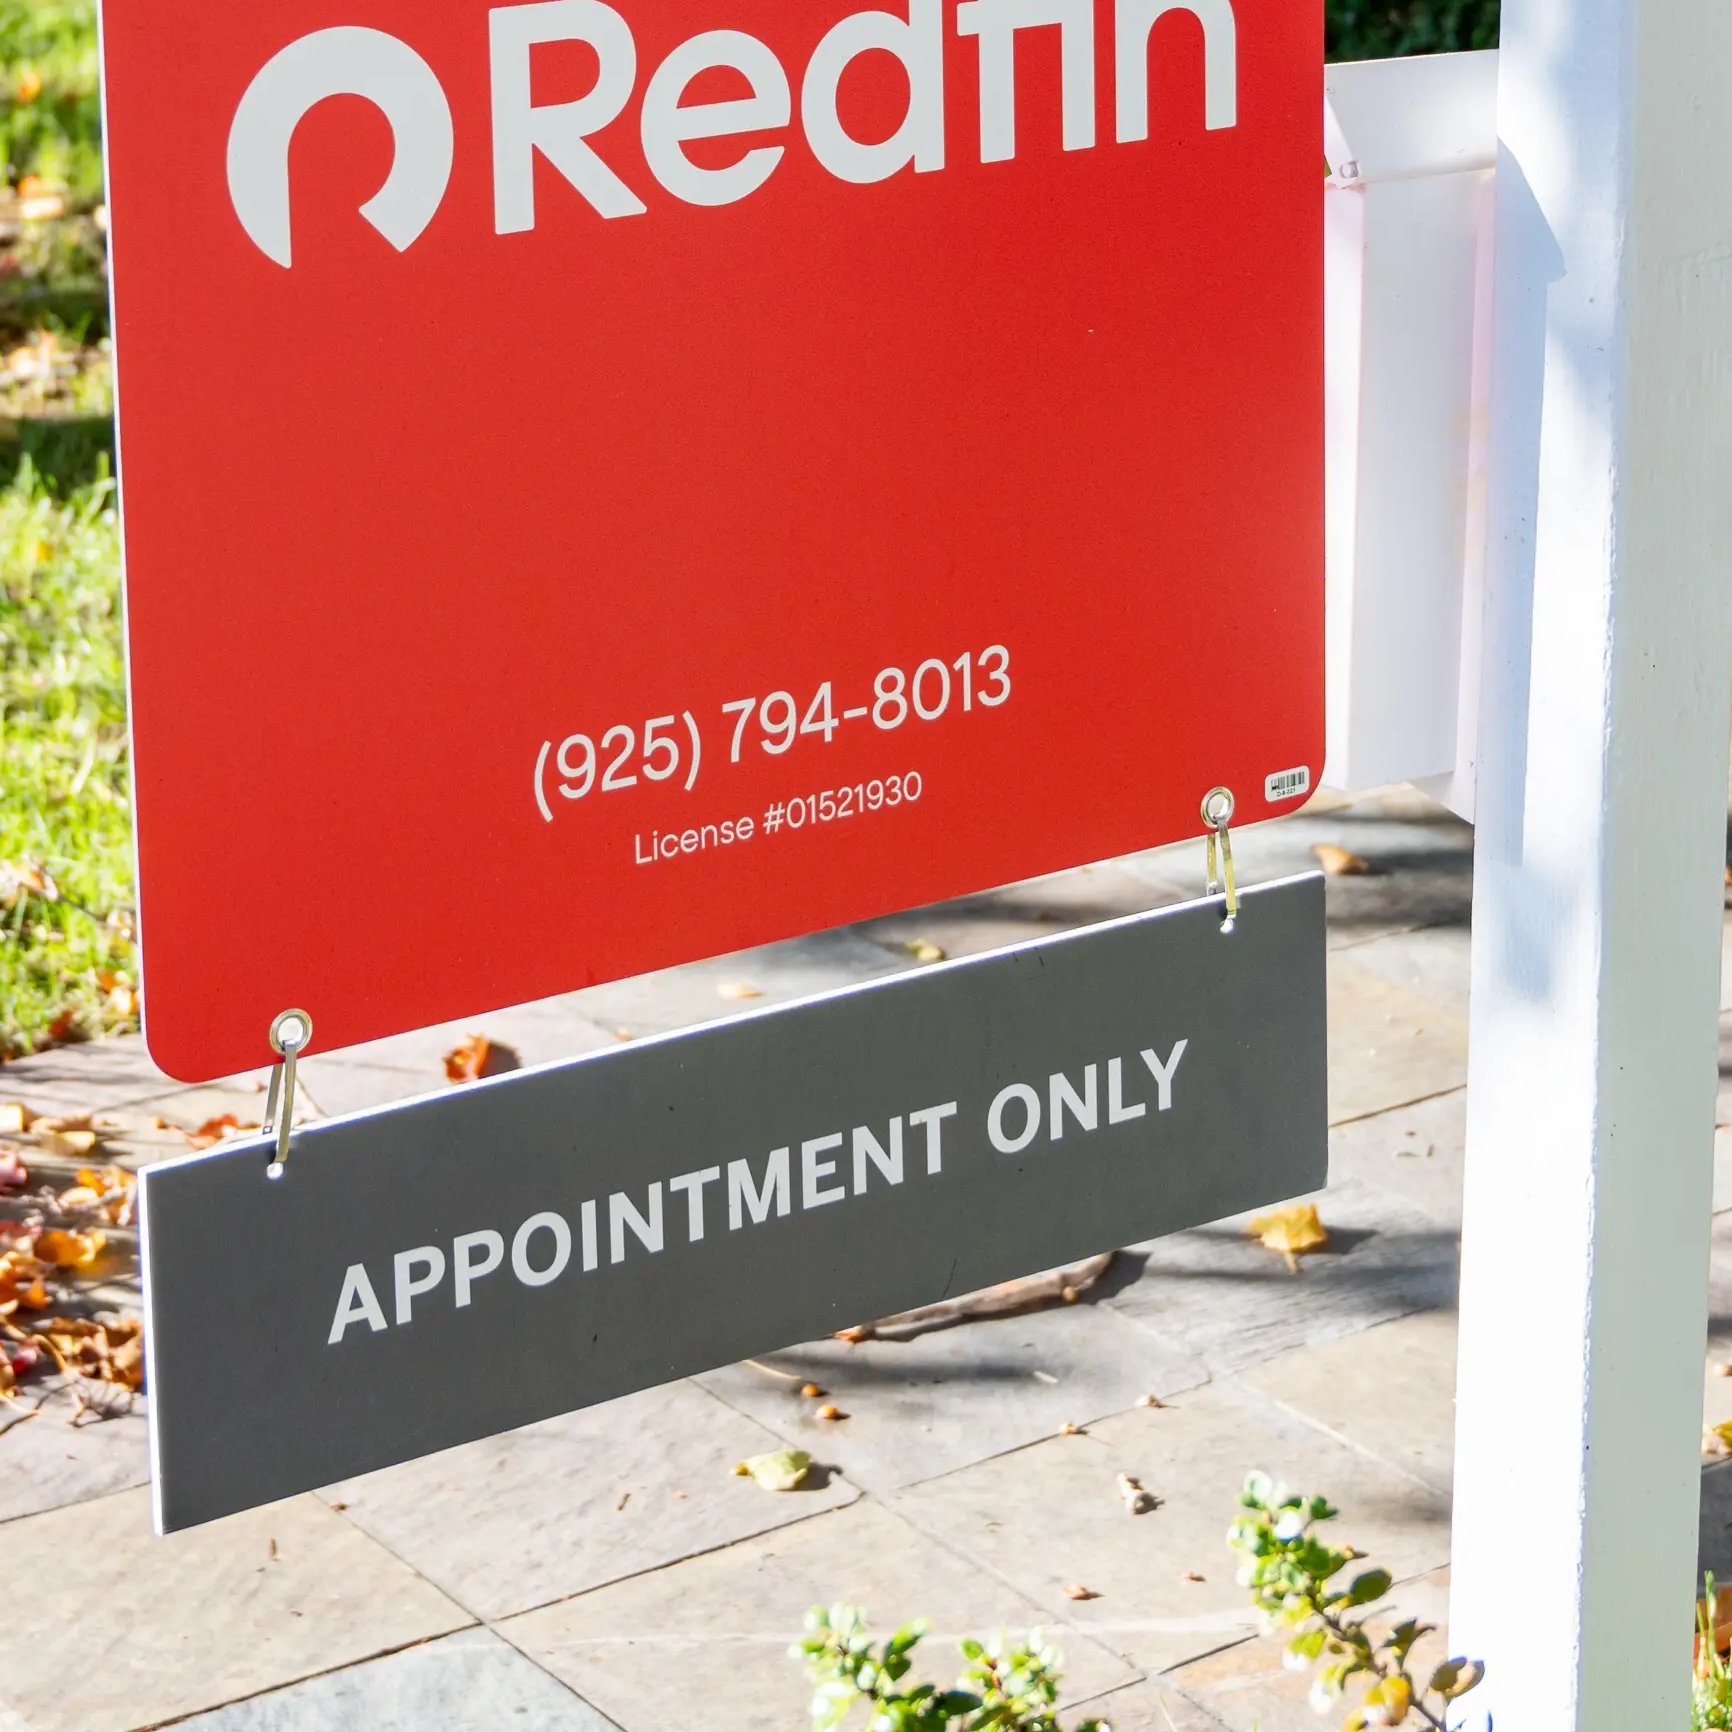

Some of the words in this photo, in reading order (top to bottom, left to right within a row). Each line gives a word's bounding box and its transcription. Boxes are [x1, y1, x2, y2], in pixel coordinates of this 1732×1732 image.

[534, 710, 701, 824] (925)
[721, 644, 1012, 764] 794-8013
[634, 816, 755, 866] License
[762, 771, 923, 836] #01521930
[326, 1100, 959, 1346] APPOINTMENT
[986, 1037, 1190, 1155] ONLY
